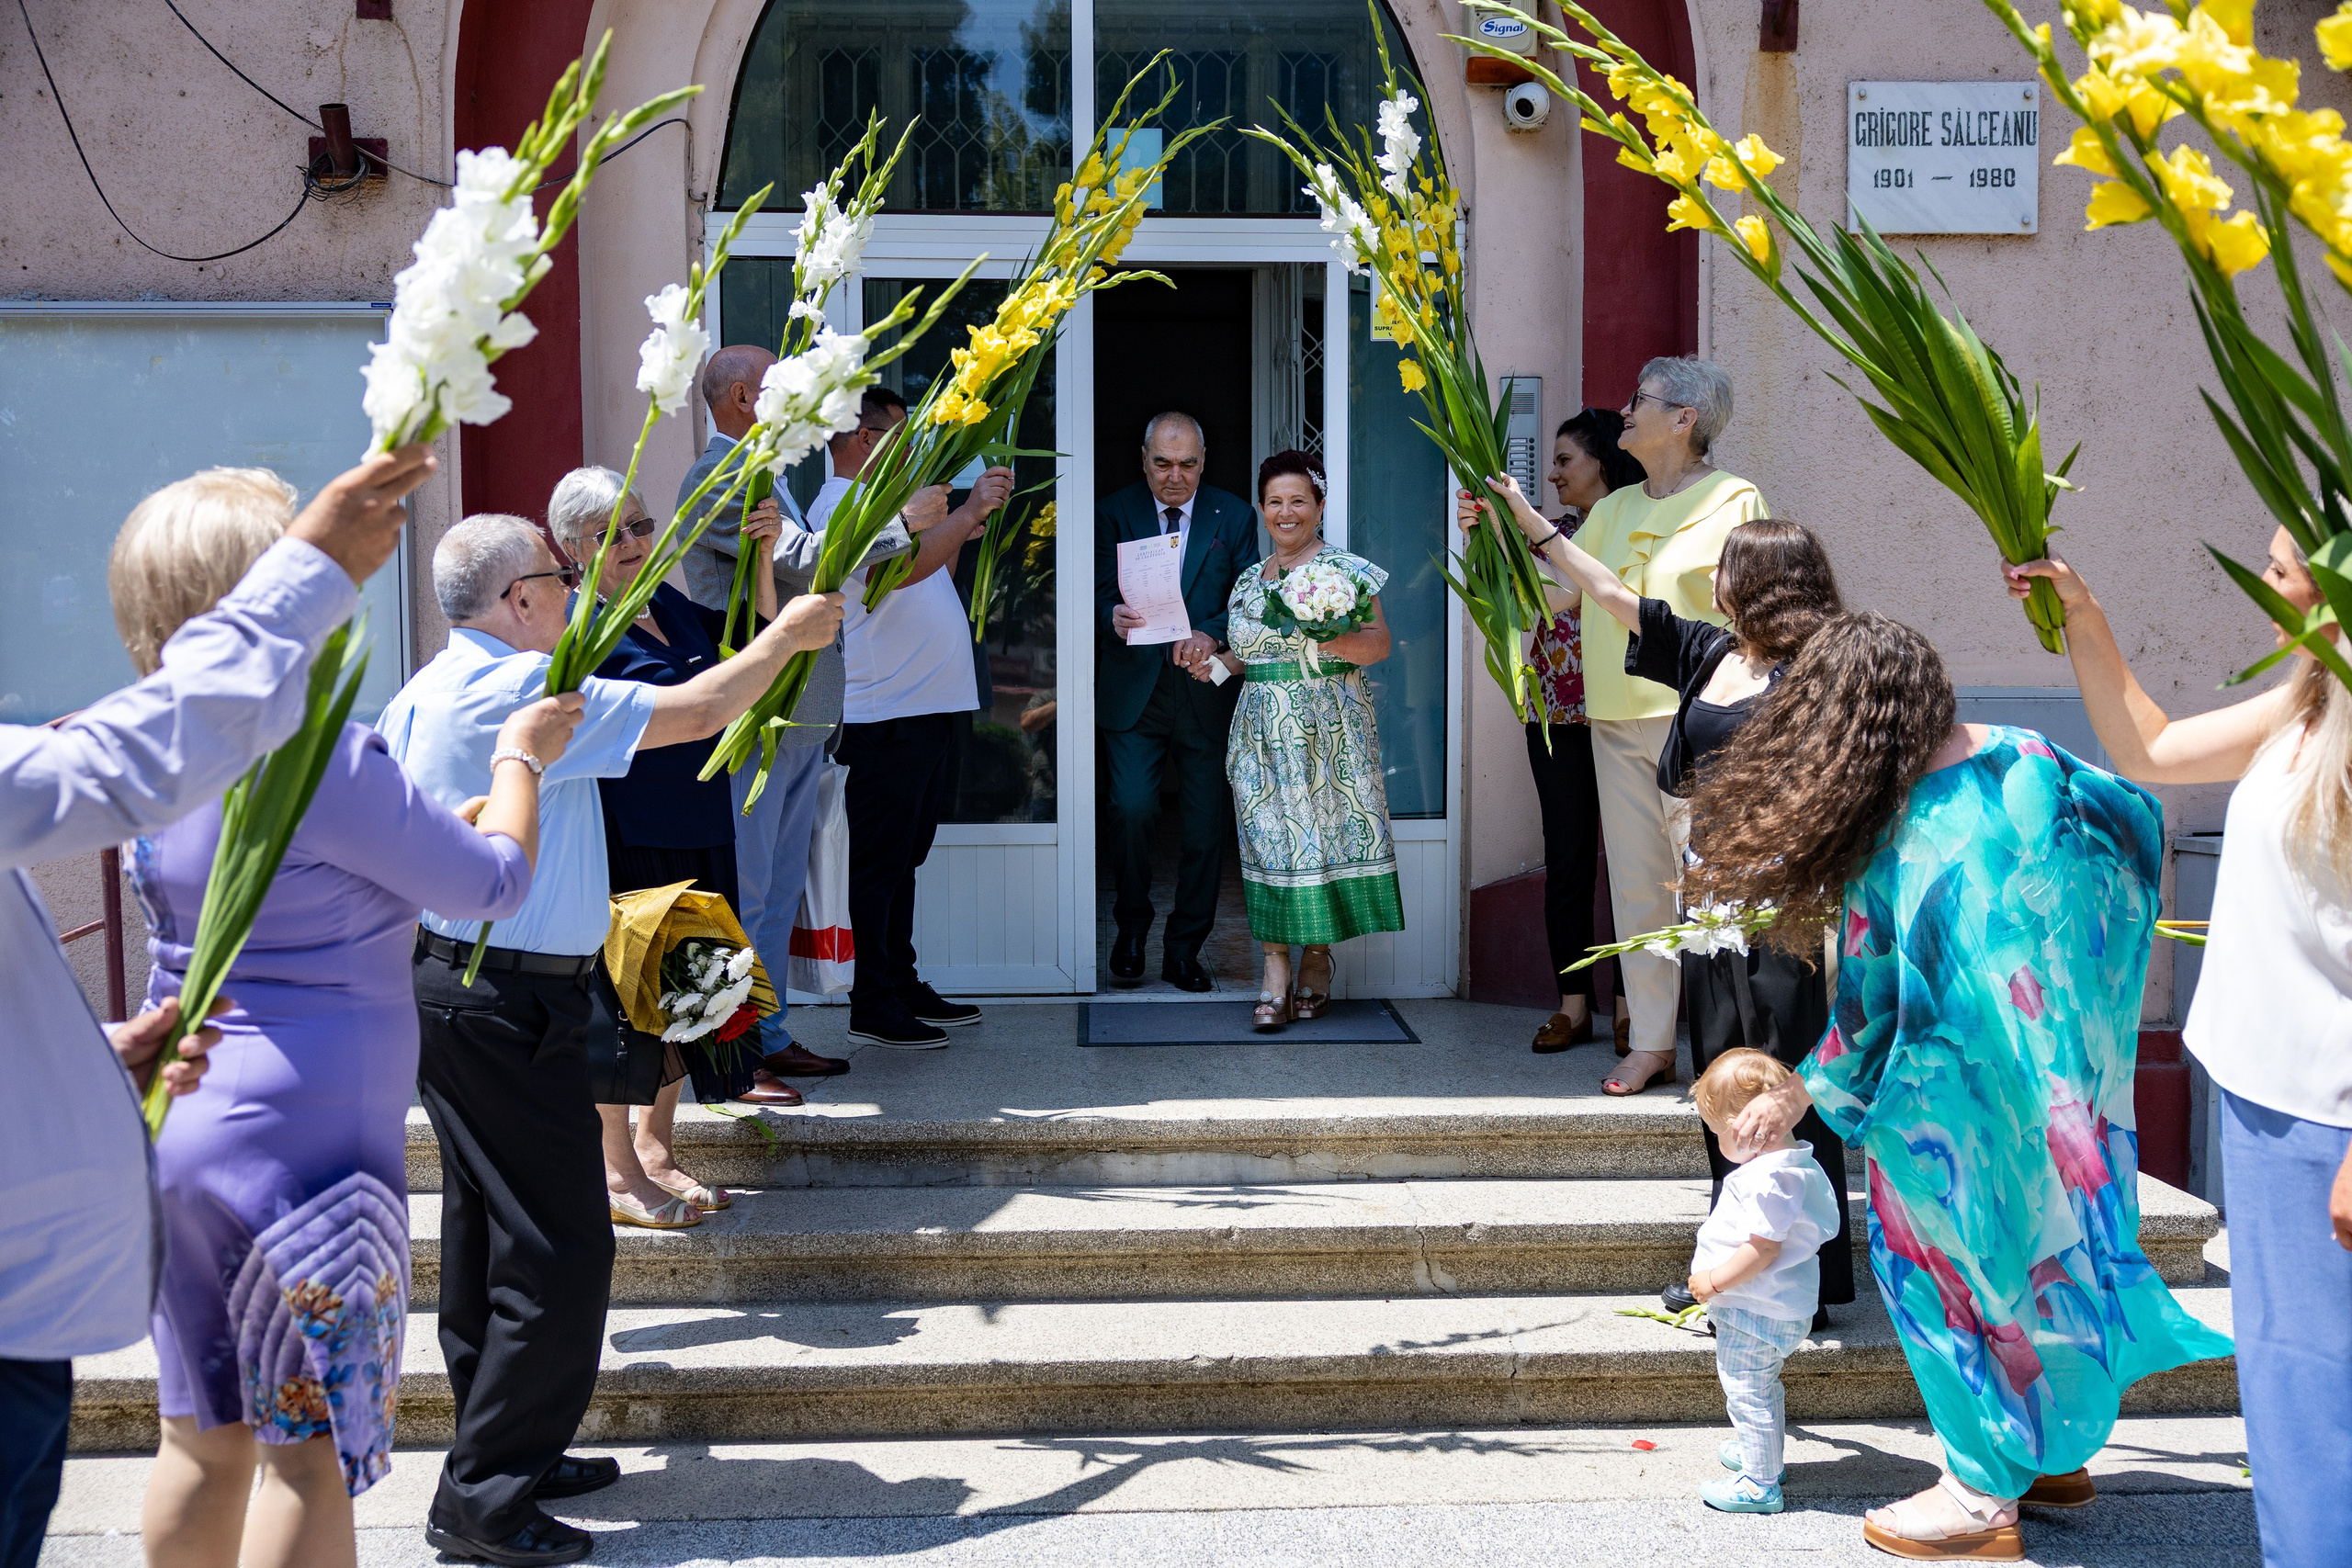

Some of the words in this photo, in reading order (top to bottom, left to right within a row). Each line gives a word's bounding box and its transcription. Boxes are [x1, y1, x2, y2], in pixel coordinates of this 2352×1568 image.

[1484, 21, 1523, 35] Signal
[1873, 168, 1913, 187] 1901
[1970, 168, 2016, 187] 1980
